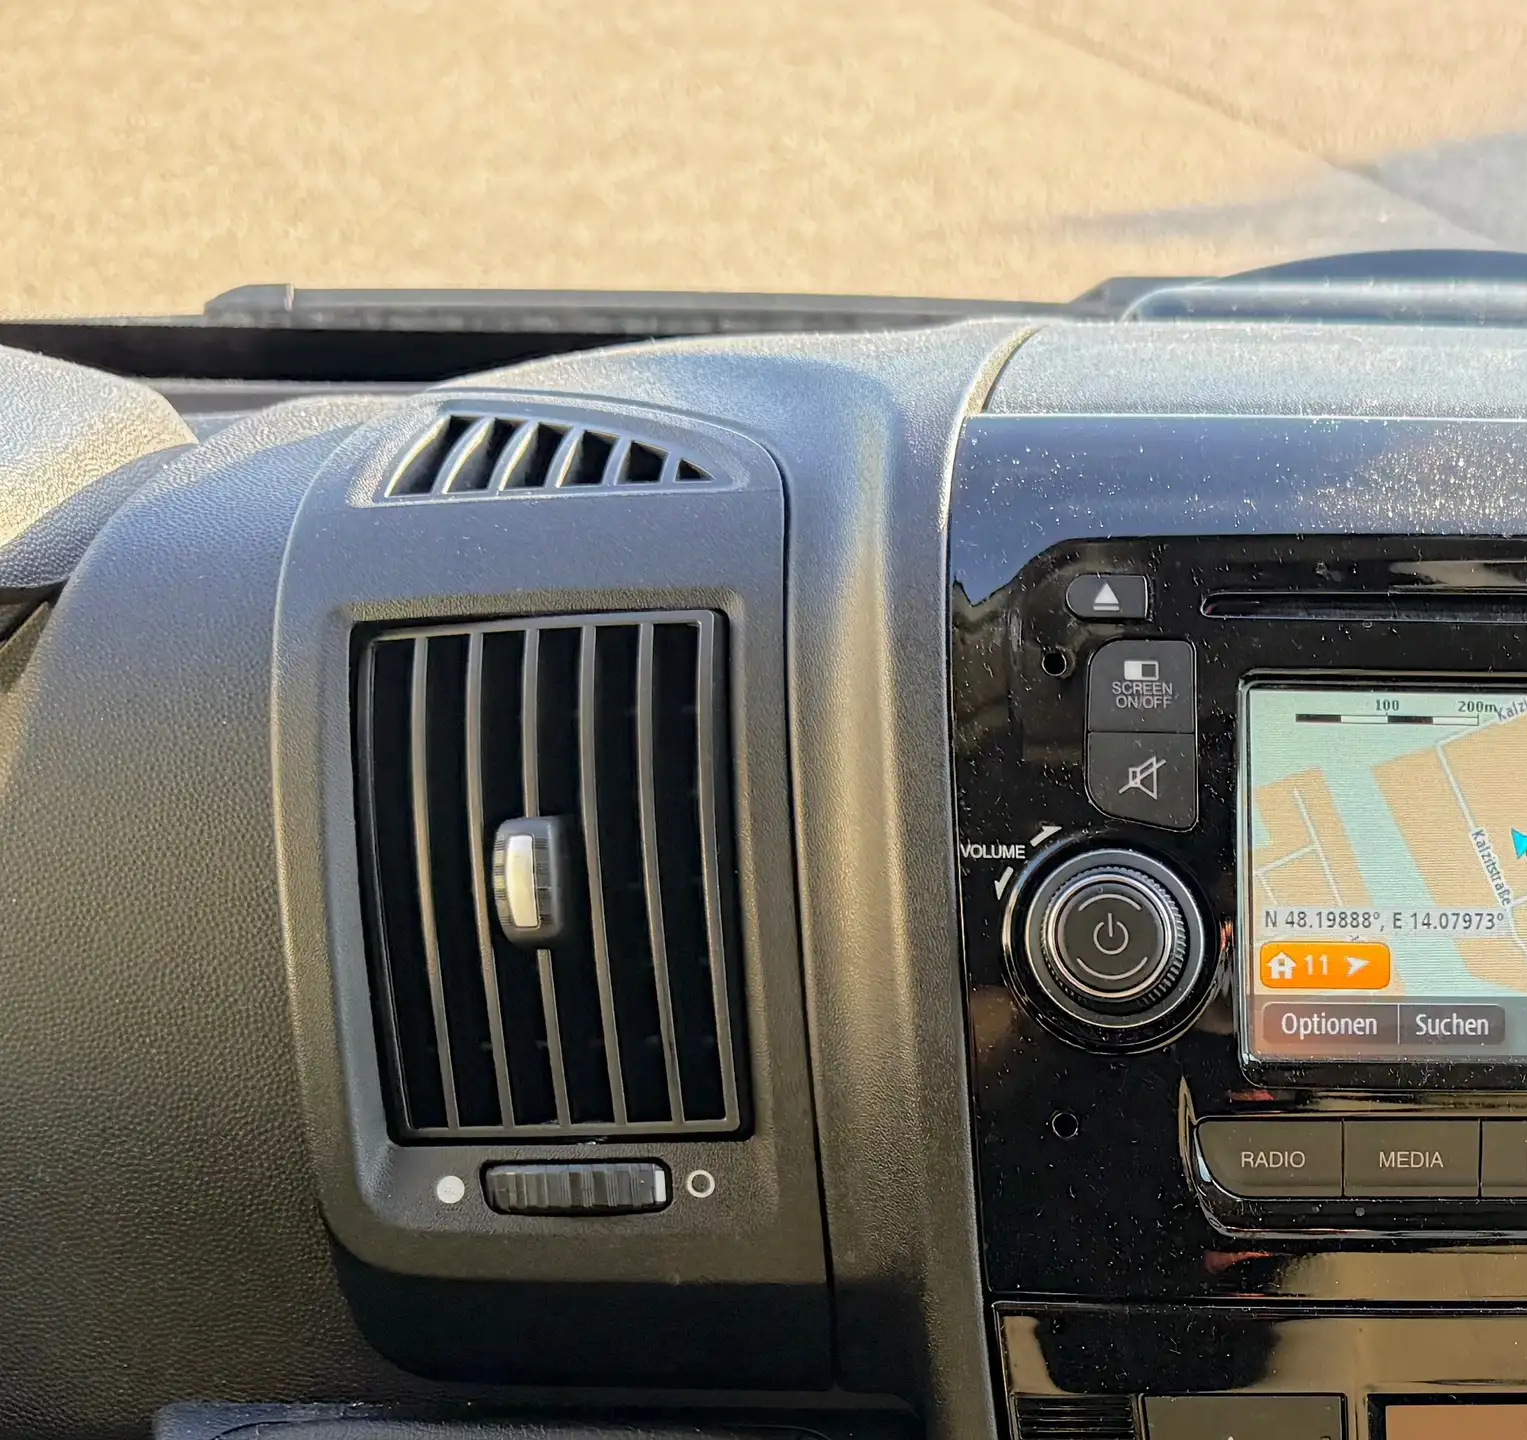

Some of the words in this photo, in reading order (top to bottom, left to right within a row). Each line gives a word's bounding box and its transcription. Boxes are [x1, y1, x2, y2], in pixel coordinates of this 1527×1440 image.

[1112, 682, 1173, 695] SCREEN
[1115, 695, 1172, 709] ON/OFF
[1375, 699, 1399, 711] 100
[1457, 700, 1497, 713] 200m
[961, 845, 1026, 859] VOLUME
[1471, 829, 1511, 905] Kalzitstraße
[1265, 911, 1277, 928] N
[1393, 913, 1402, 930] E
[1304, 954, 1328, 976] 11
[1281, 1013, 1378, 1036] Optionen
[1415, 1013, 1489, 1036] Suchen
[1240, 1150, 1306, 1169] RADIO
[1378, 1150, 1444, 1169] MEDIA
